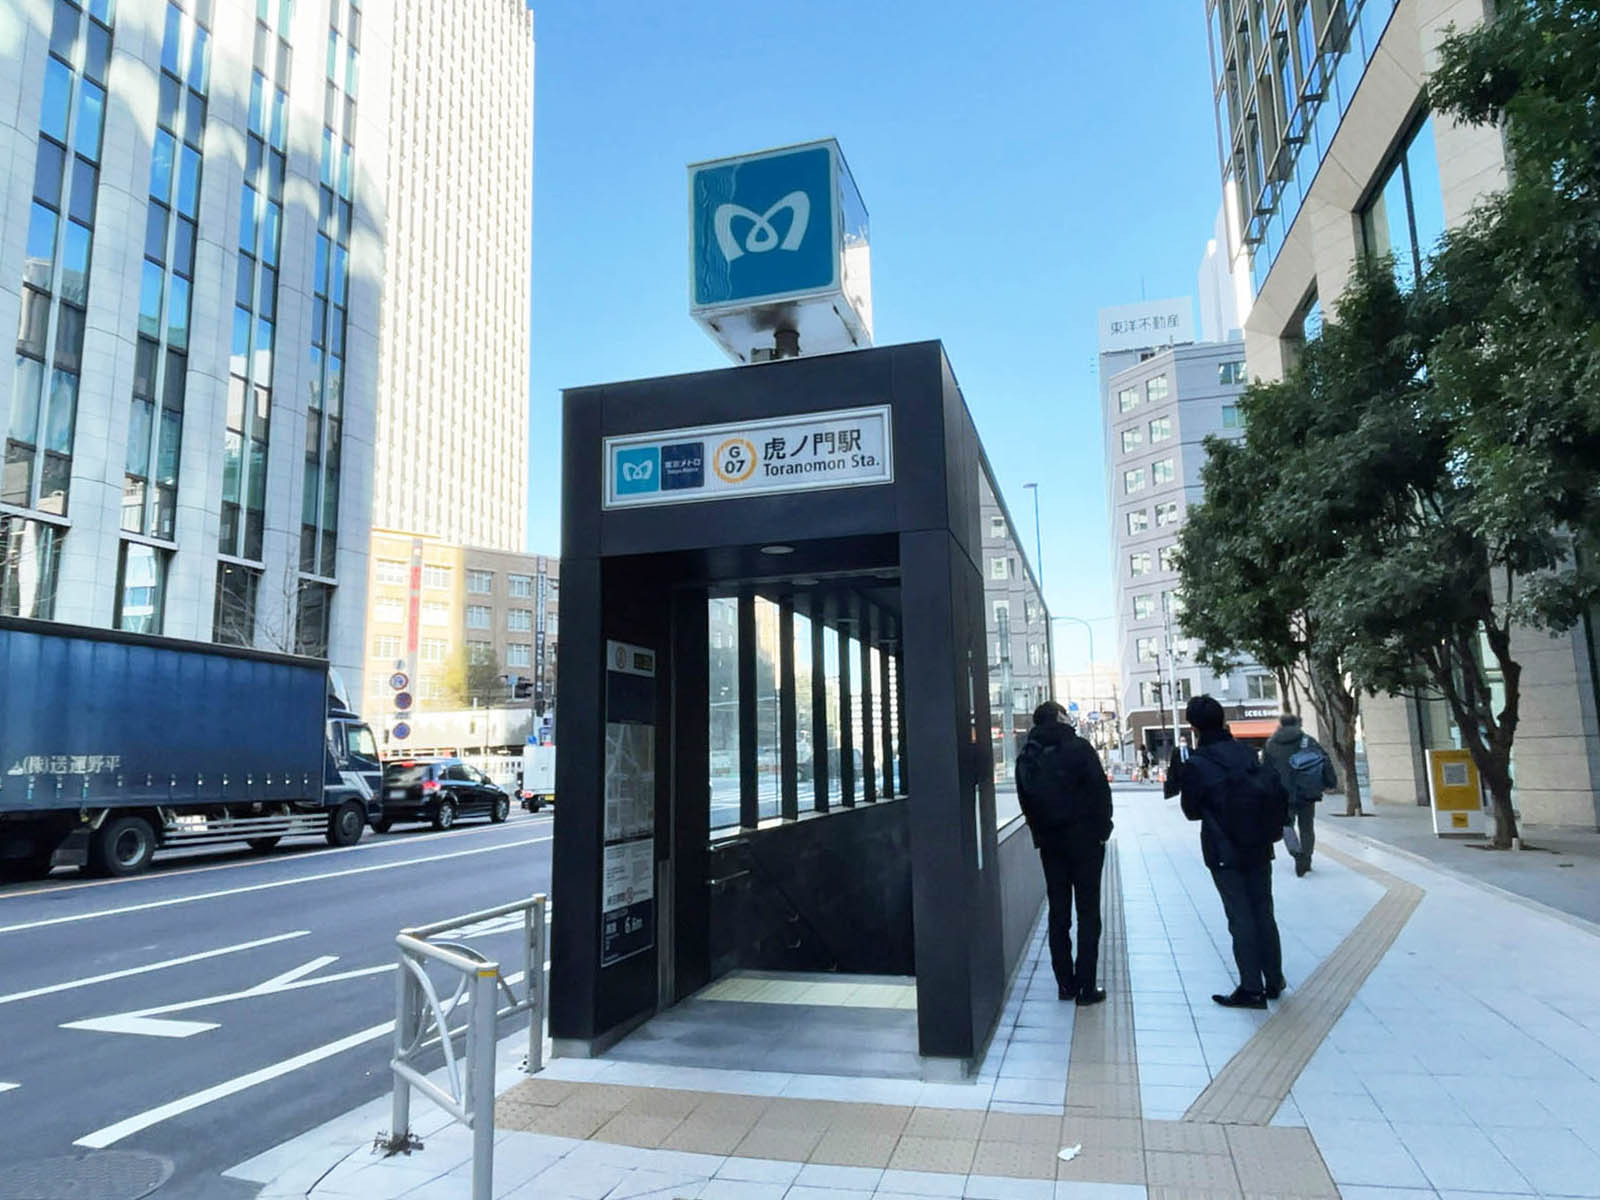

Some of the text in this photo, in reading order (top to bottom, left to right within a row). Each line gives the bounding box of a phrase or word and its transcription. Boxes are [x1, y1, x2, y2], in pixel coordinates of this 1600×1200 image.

[1111, 314, 1179, 335] 東洋不動産
[729, 446, 741, 458] G
[763, 429, 861, 460] 虎ノ門駅
[724, 460, 746, 474] 07
[763, 454, 880, 476] Toranomon Sta.
